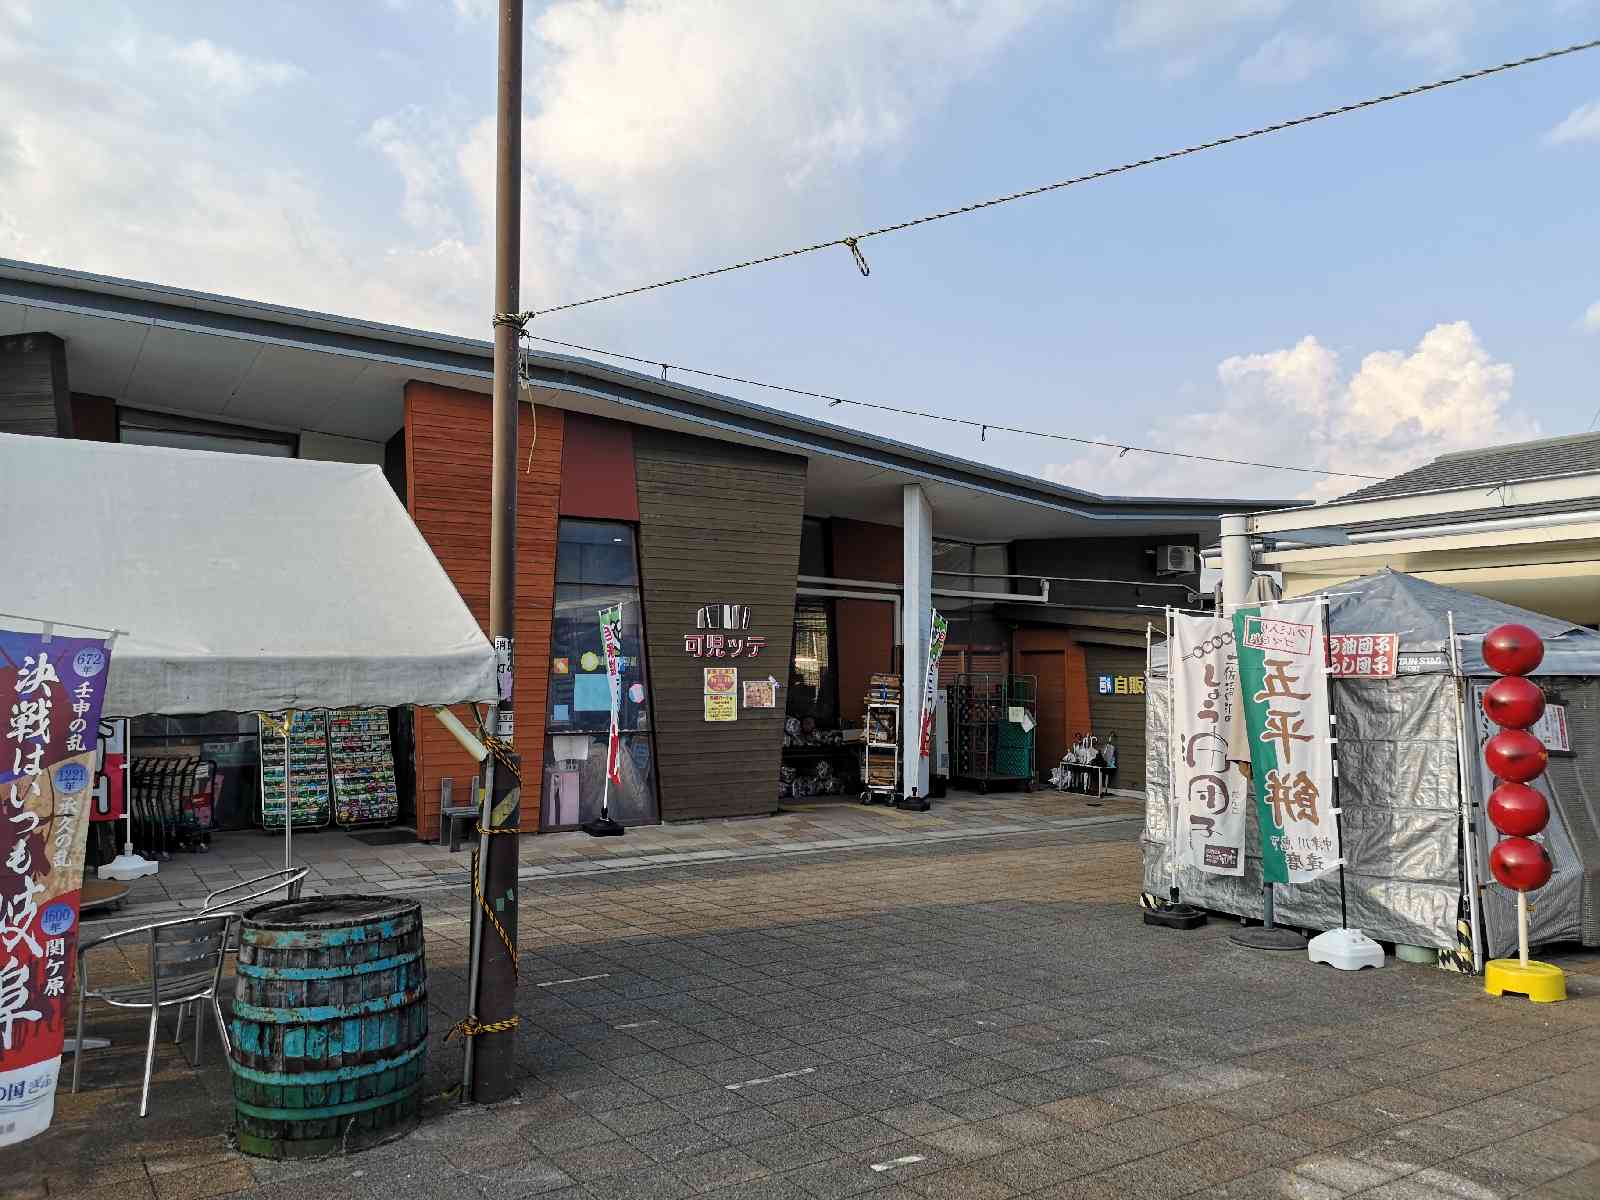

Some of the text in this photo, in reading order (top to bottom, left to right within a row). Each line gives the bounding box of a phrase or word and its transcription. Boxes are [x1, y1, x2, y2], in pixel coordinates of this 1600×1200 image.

[684, 634, 768, 657] 可児ッテ
[77, 653, 101, 665] 672
[66, 681, 94, 752] 壬申の乱
[44, 909, 70, 924] 1600
